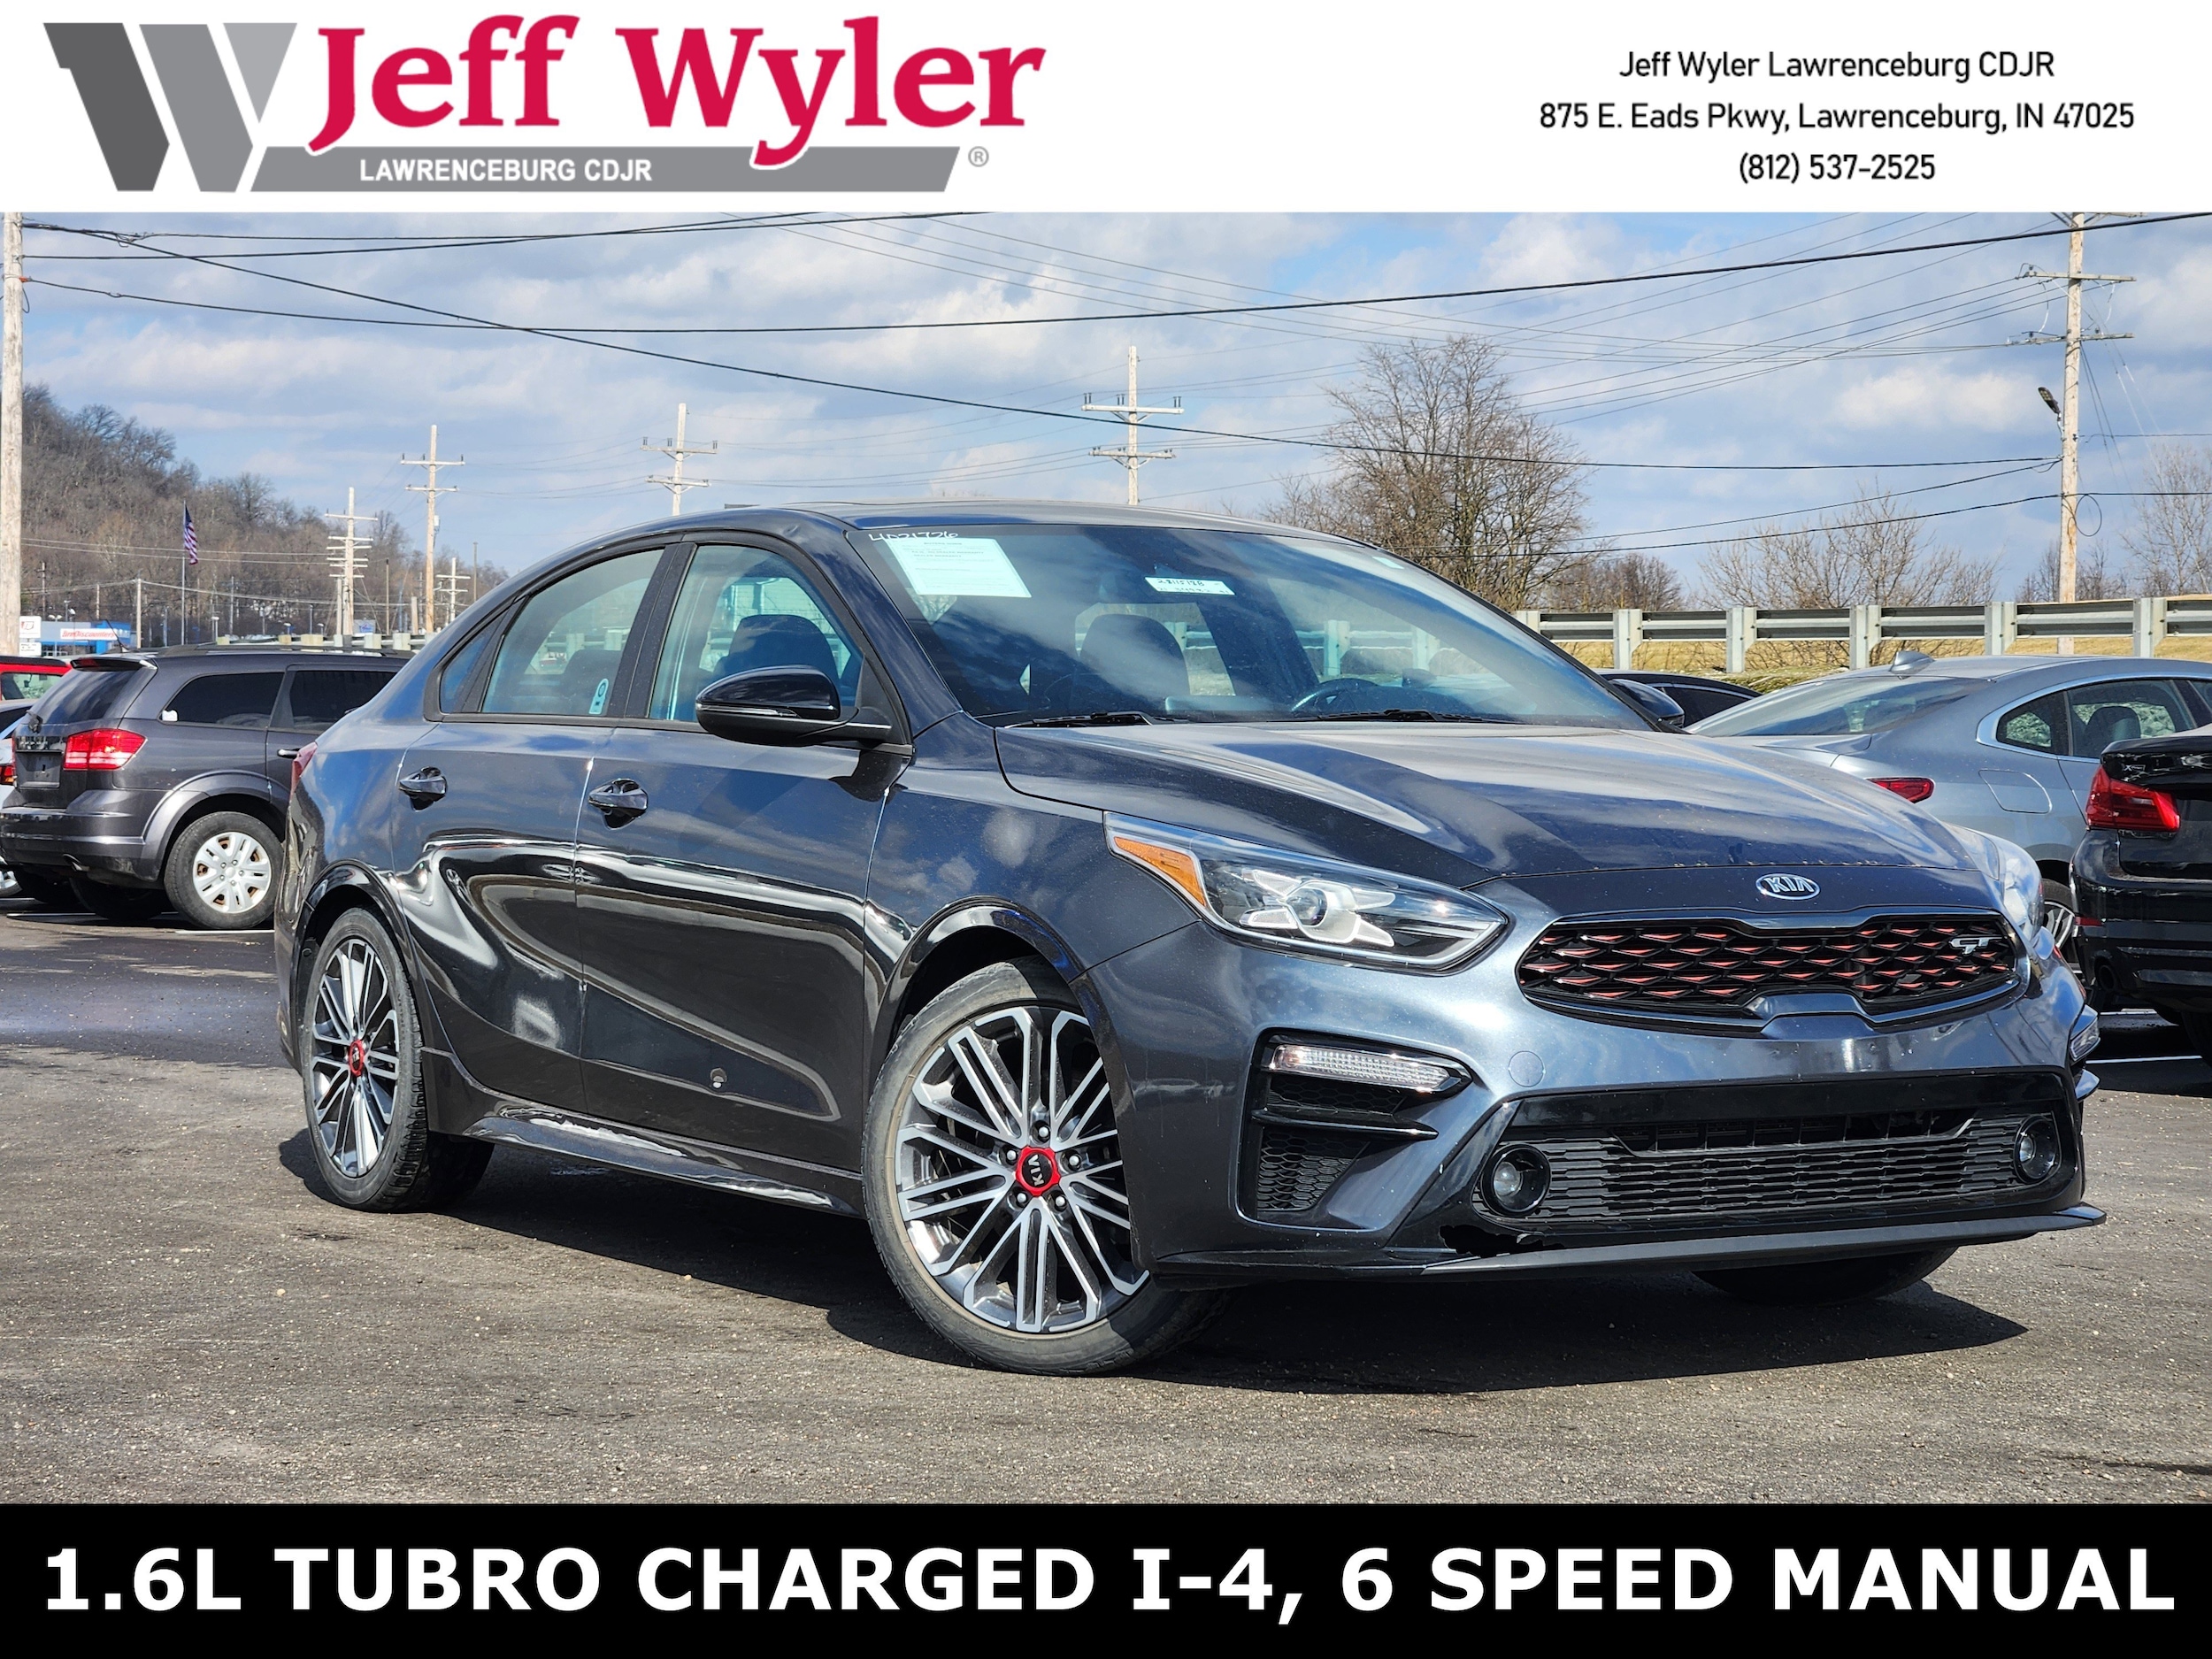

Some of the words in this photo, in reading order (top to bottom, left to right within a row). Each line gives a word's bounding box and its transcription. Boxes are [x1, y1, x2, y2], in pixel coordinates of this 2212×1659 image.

[1763, 876, 1815, 893] KIA
[1949, 936, 2000, 955] GT
[1028, 1154, 1045, 1187] KIA
